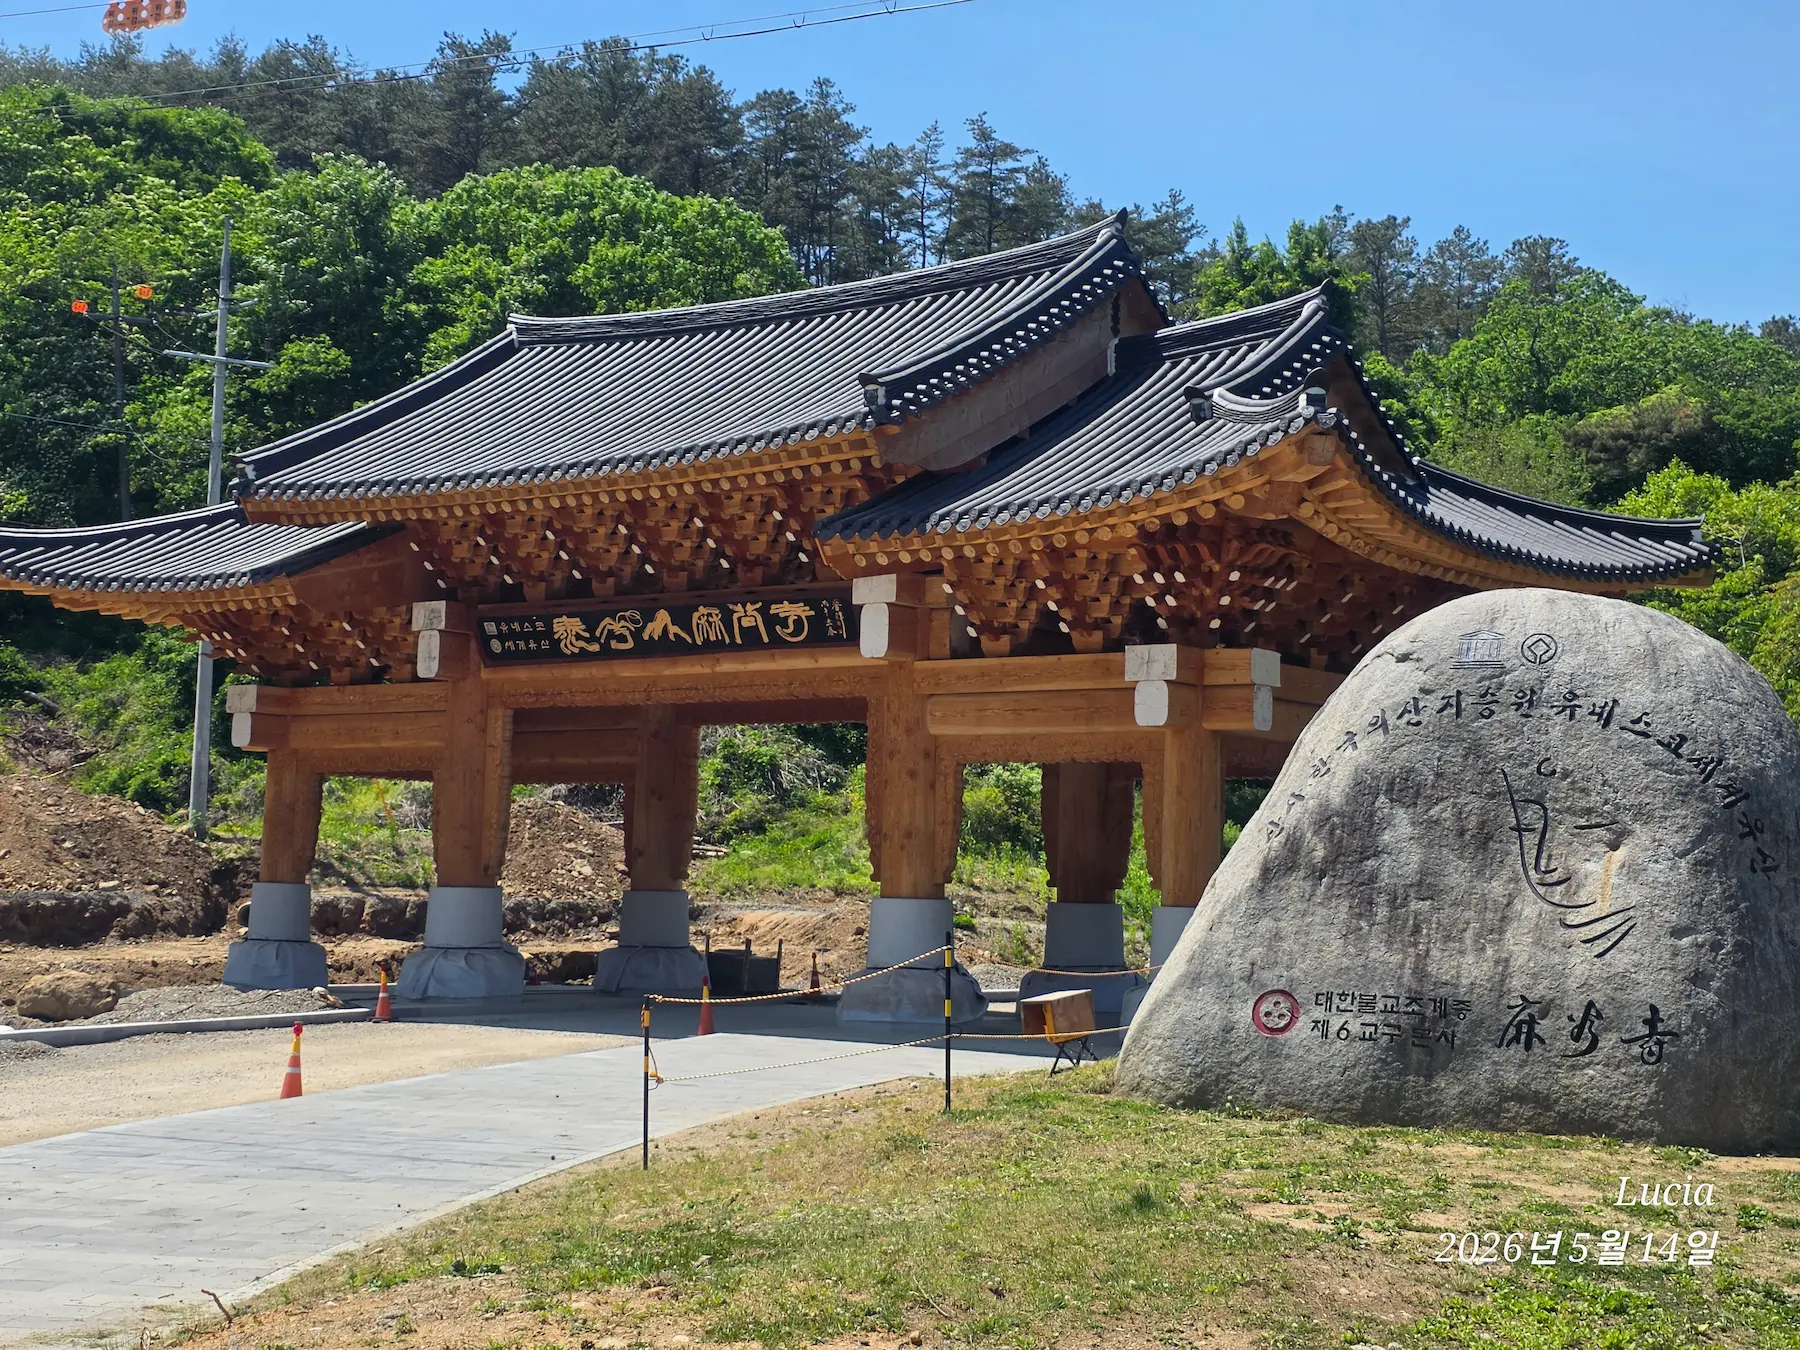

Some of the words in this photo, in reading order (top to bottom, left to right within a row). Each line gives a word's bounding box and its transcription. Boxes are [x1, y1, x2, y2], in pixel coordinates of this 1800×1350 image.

[499, 621, 546, 634] 유네스코
[505, 639, 550, 651] 세계유산
[1550, 689, 1689, 760] 유네스코
[1314, 990, 1473, 1021] 대한불교조계종
